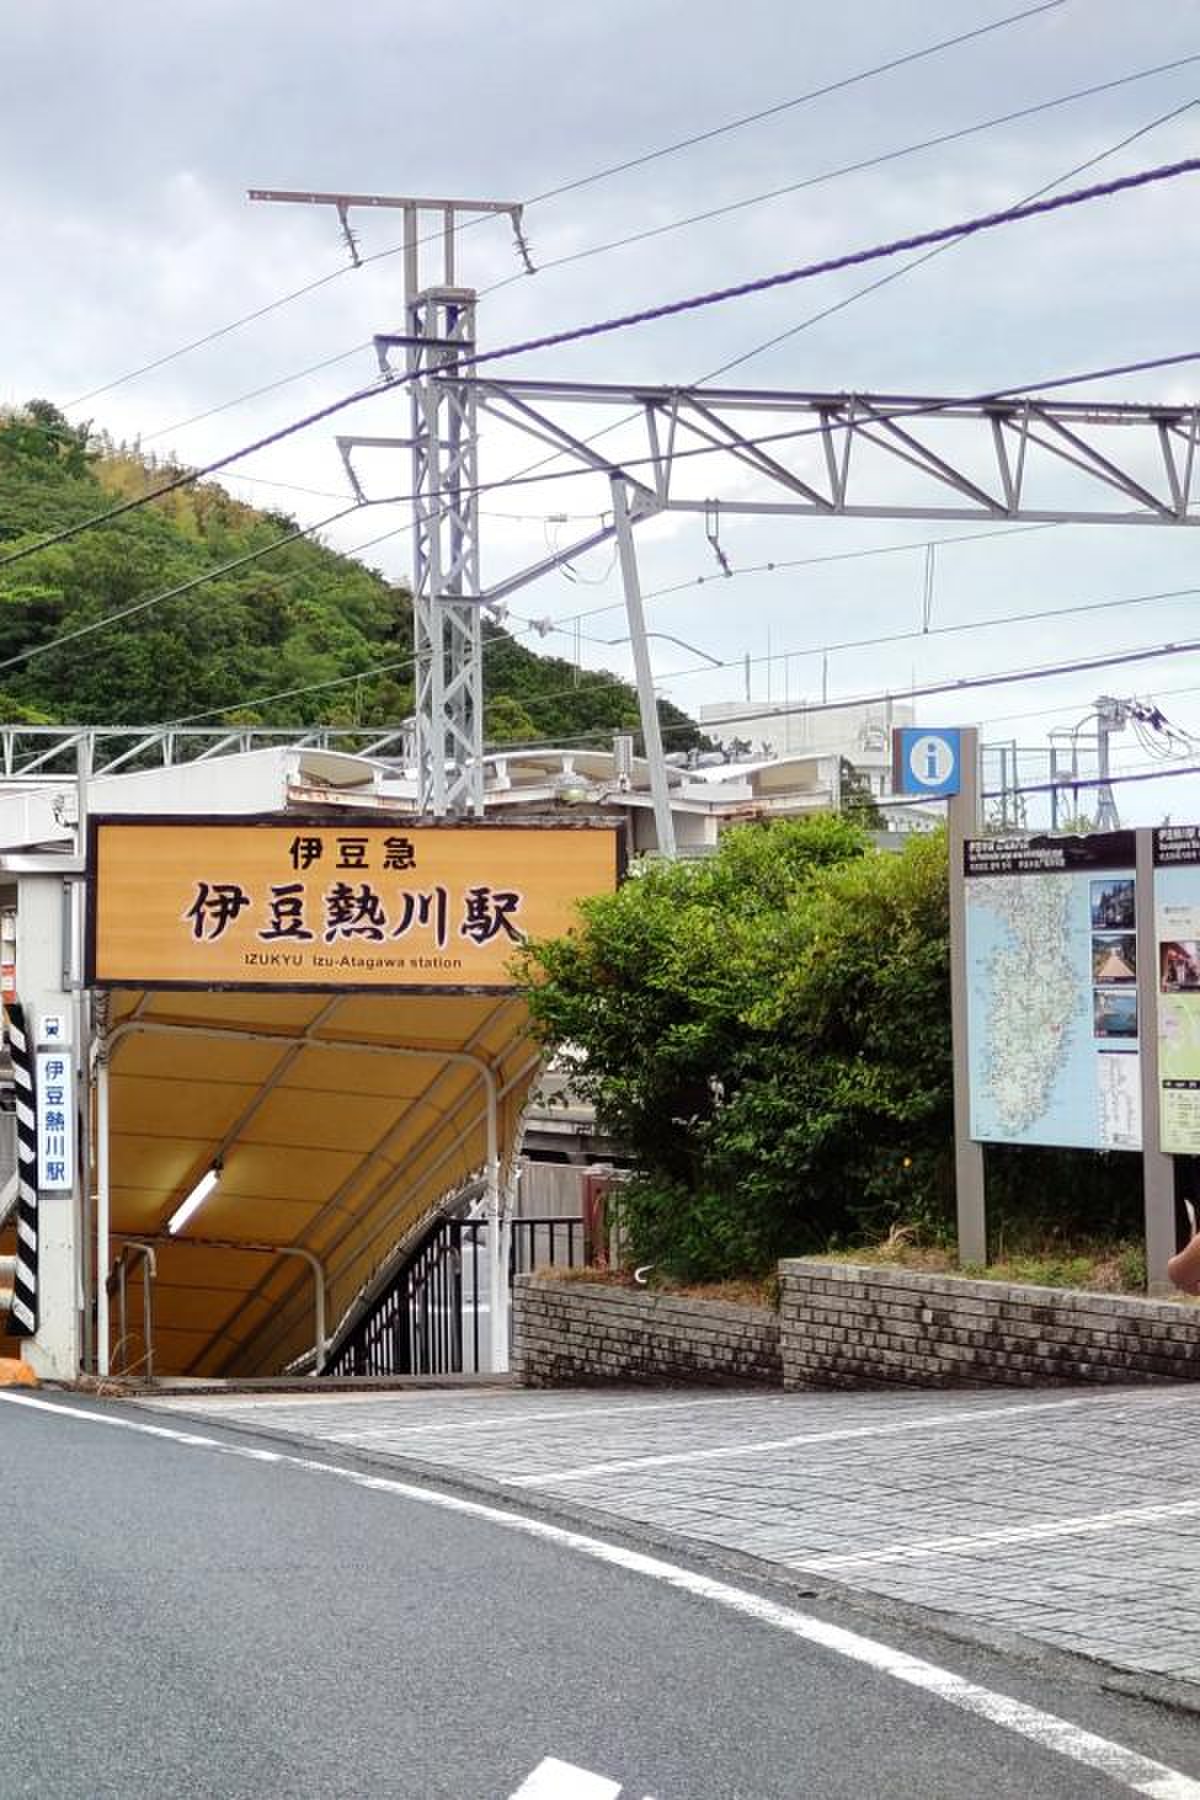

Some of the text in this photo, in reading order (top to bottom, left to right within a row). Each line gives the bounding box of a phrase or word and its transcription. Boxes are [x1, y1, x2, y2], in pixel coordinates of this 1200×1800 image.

[288, 836, 418, 870] 伊豆急
[186, 881, 525, 947] 伊豆熱川駅
[244, 953, 462, 972] IZUKYU Izu-Atagawa station
[44, 1059, 65, 1182] 伊豆熱川駅
